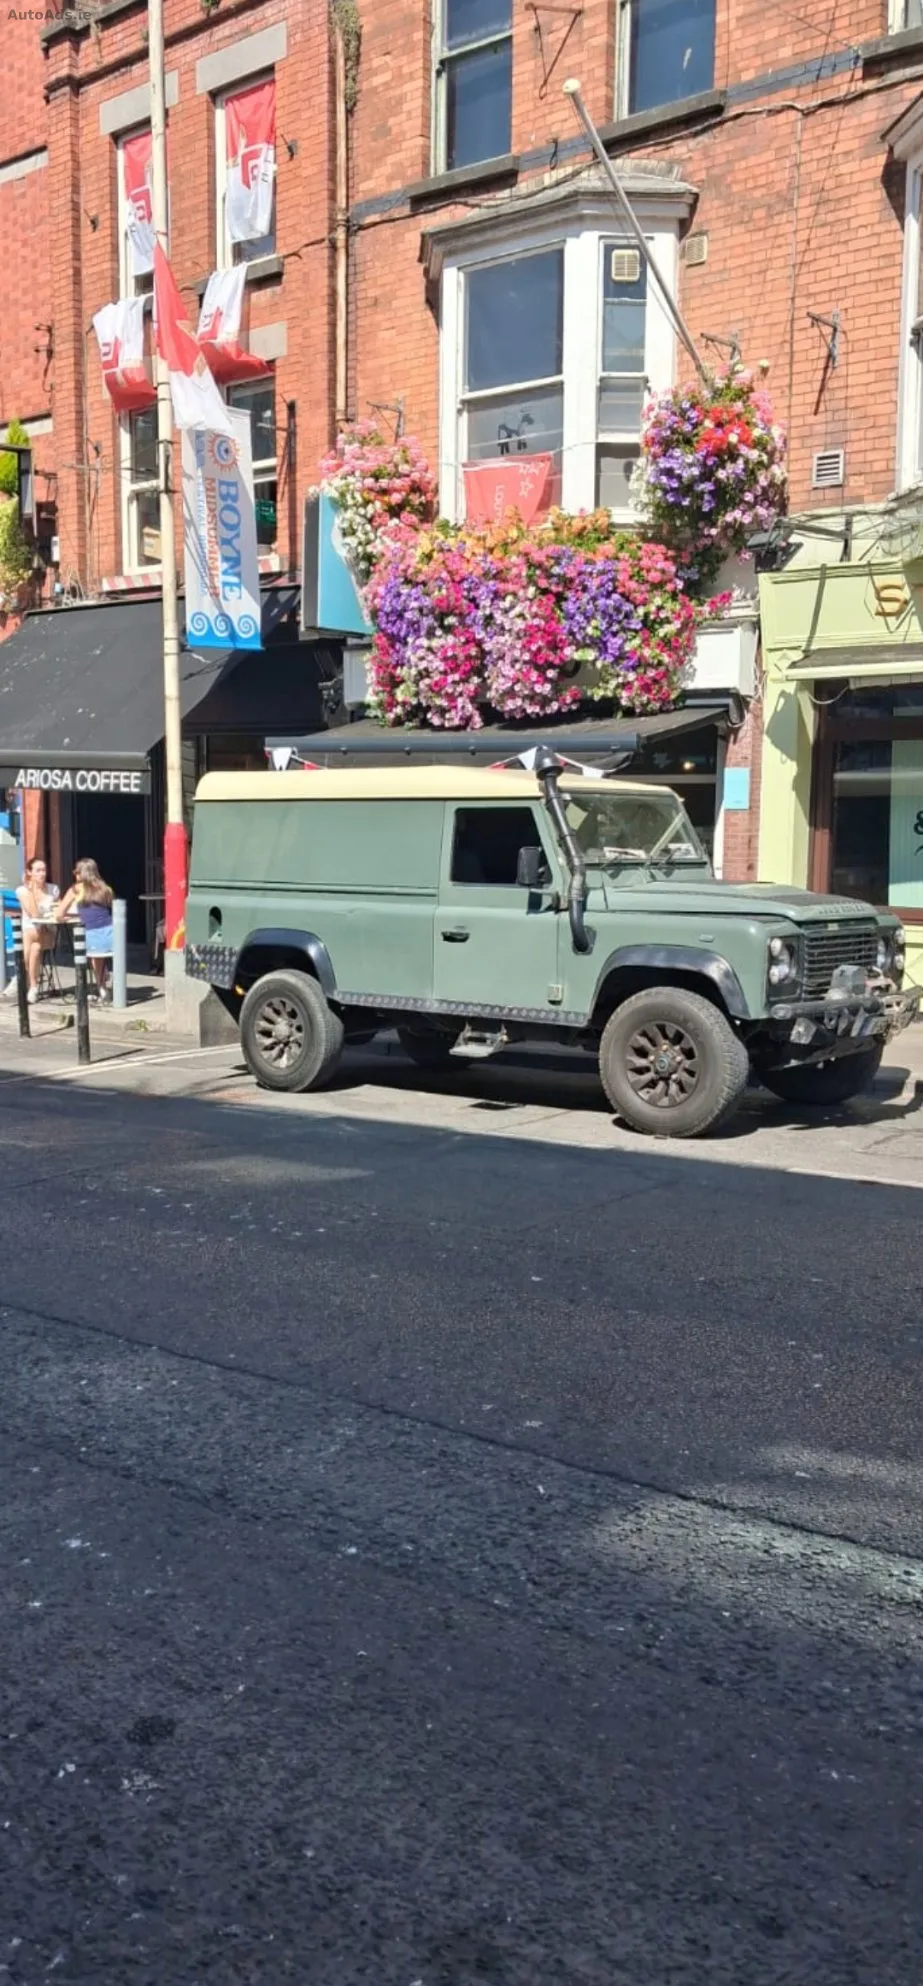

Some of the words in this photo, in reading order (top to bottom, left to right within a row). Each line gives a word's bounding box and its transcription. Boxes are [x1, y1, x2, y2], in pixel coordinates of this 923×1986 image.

[205, 477, 220, 597] MIDSUMMER
[218, 480, 241, 601] BOYNE
[15, 769, 73, 790] ARIOSA
[75, 771, 141, 793] COFFEE
